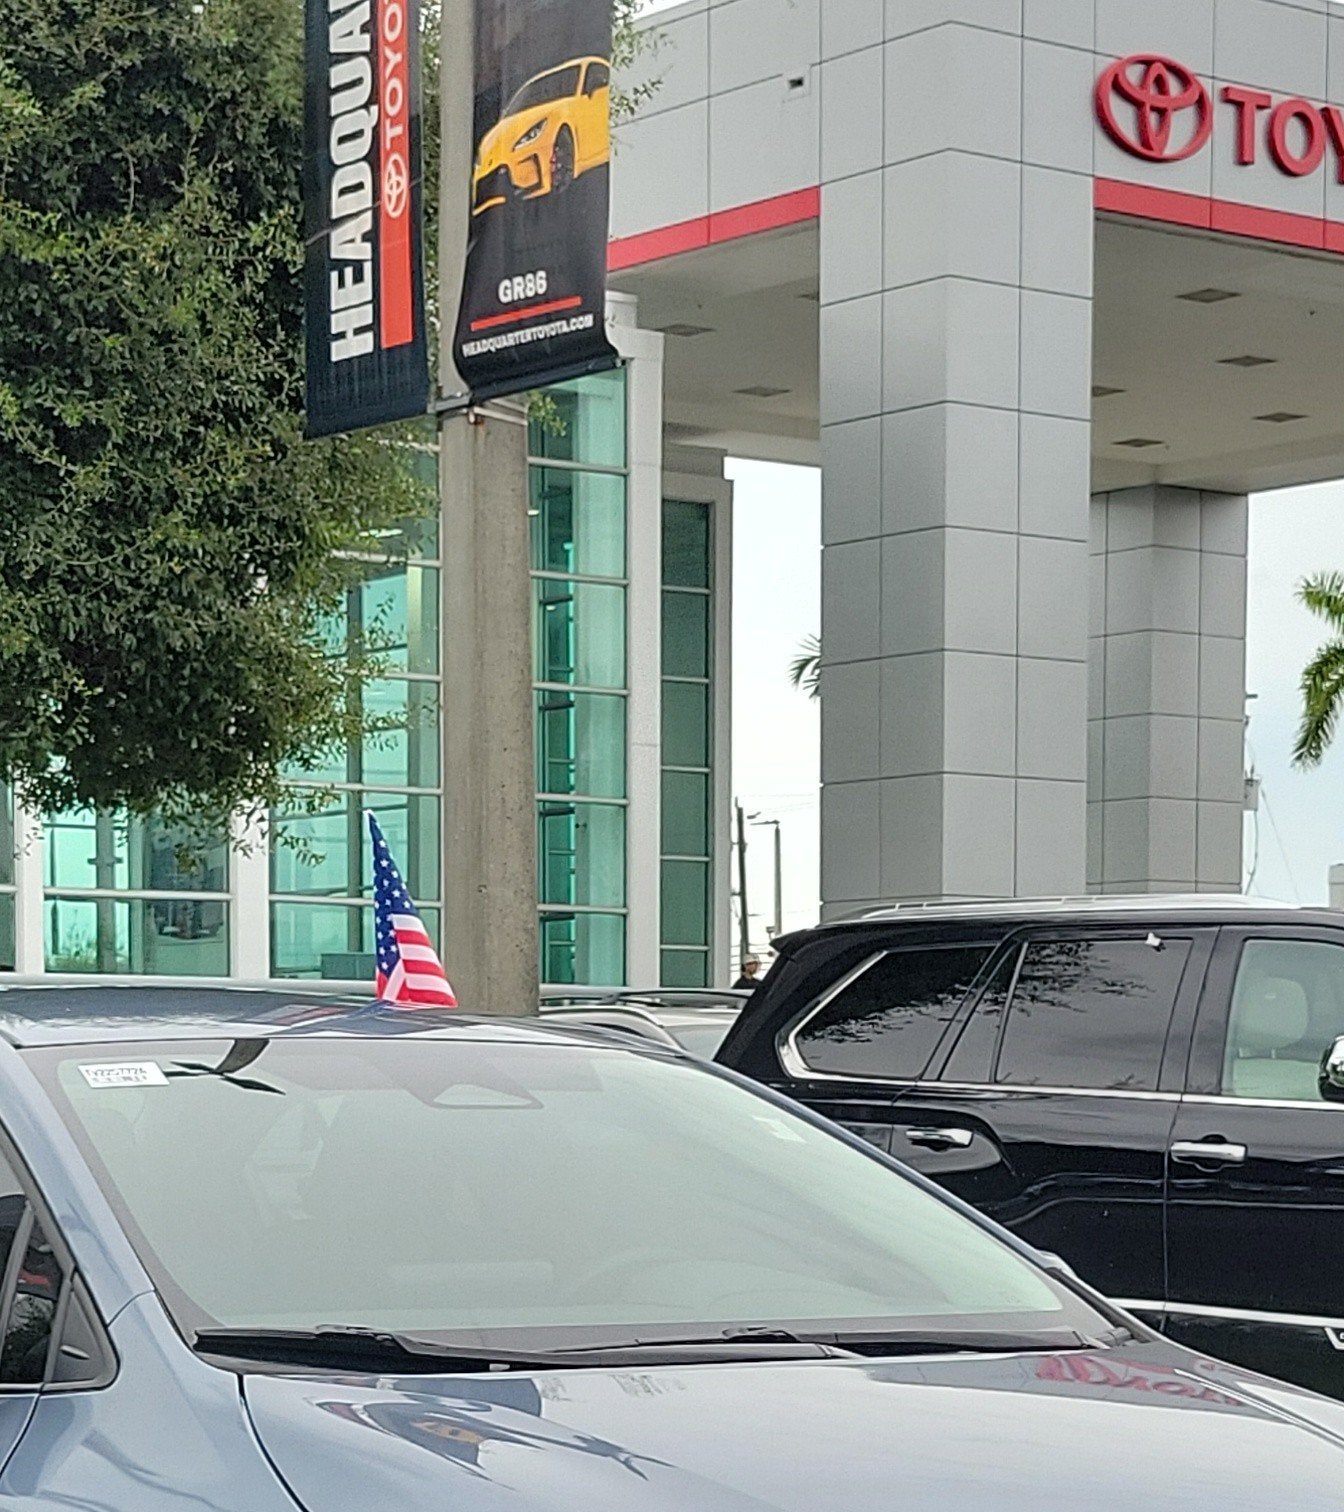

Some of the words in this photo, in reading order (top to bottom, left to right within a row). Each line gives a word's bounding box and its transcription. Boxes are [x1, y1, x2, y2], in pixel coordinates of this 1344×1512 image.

[384, 0, 405, 151] TOYO
[329, 0, 379, 364] HEADQUA
[461, 313, 595, 358] HEADQUARTERTOYOTA.COM
[498, 270, 548, 304] GR86
